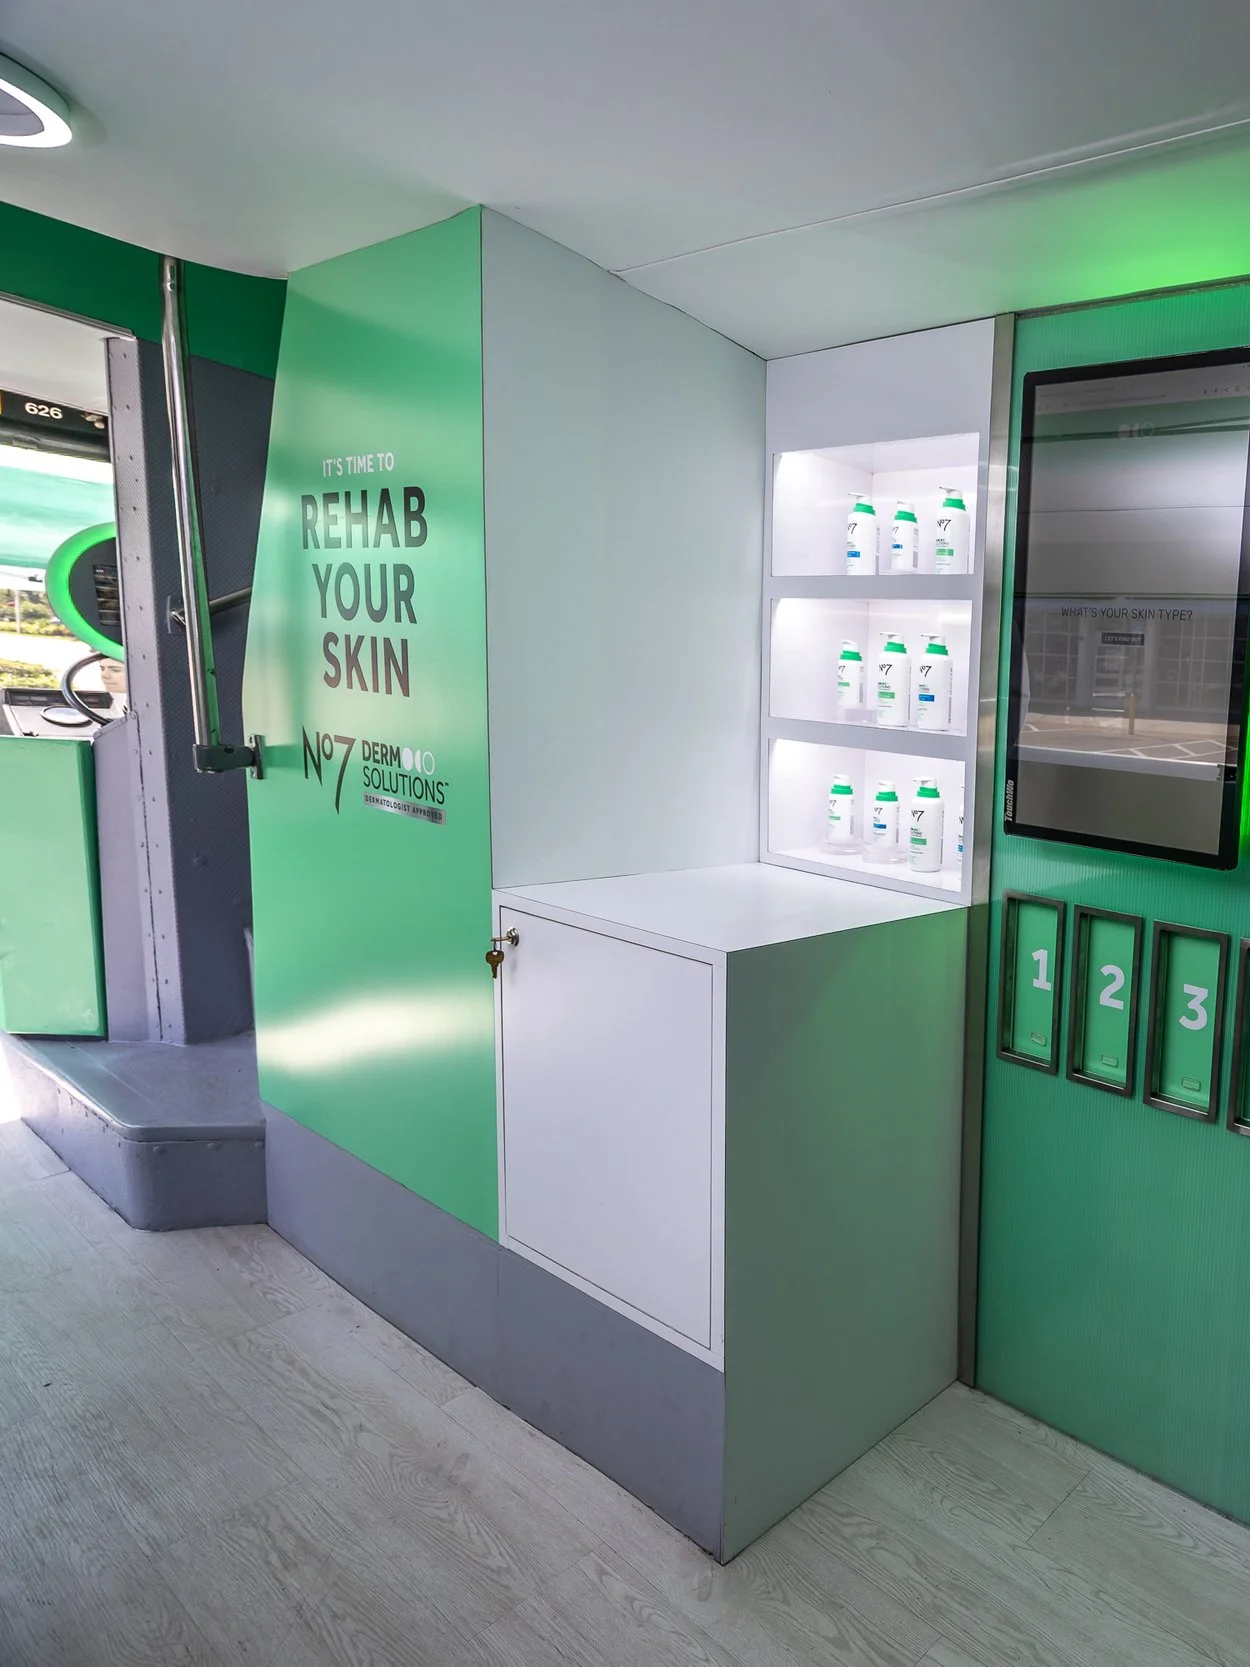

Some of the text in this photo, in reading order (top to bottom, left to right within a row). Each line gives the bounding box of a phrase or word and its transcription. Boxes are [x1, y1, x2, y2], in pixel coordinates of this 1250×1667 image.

[25, 402, 63, 419] 626
[323, 452, 395, 477] IT'S TIME TO
[301, 486, 428, 549] REHAB
[312, 562, 417, 624] YOUR
[1061, 606, 1193, 621] WHAT'S YOUR SKIN TYPE?
[323, 631, 410, 697] SKIN
[362, 740, 401, 769] DERM
[364, 794, 443, 821] DERMATOLOGIST APPROVED
[1031, 949, 1051, 991] 1
[1100, 965, 1125, 1010] 2
[1178, 983, 1209, 1031] 3
